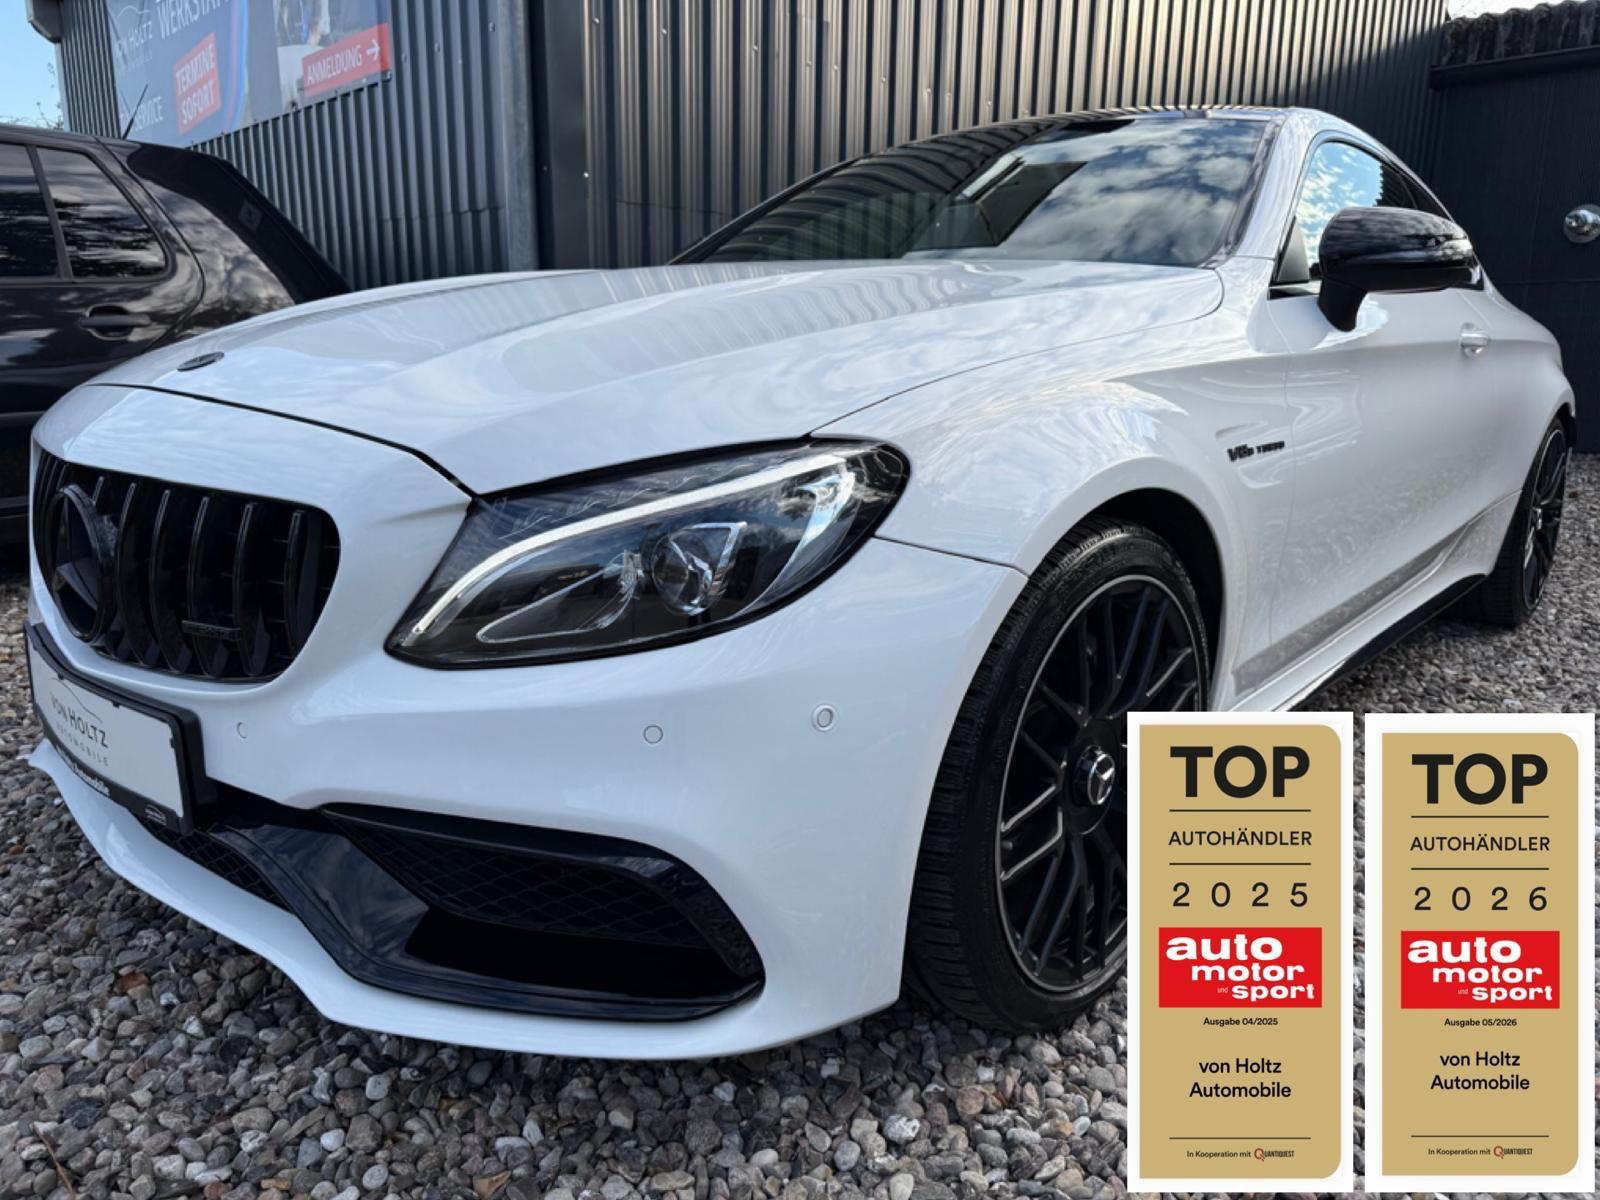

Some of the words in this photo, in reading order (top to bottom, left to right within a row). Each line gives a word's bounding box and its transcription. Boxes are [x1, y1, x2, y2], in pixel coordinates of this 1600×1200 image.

[157, 0, 229, 40] WERKST
[175, 43, 216, 95] TERMINE
[307, 44, 363, 86] ANMELDUNG
[181, 79, 215, 125] SOFORT
[67, 706, 109, 750] HOLTZ
